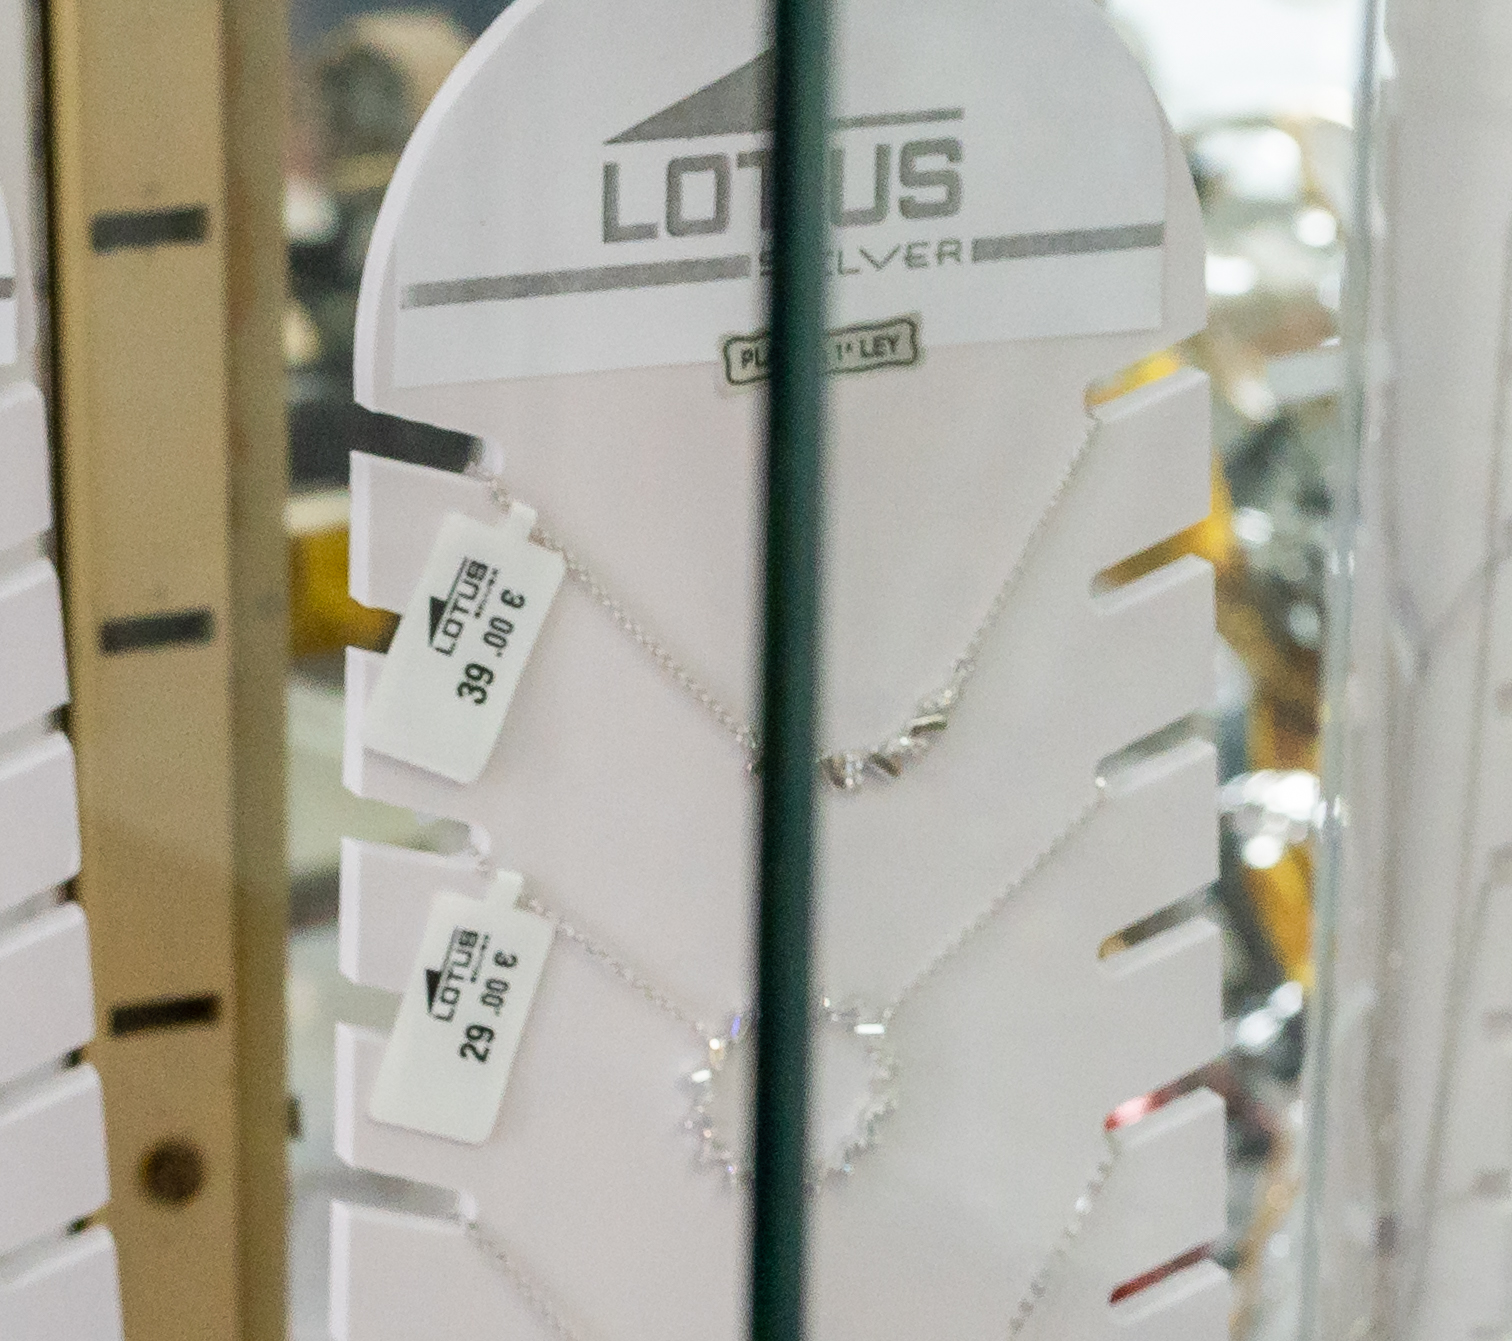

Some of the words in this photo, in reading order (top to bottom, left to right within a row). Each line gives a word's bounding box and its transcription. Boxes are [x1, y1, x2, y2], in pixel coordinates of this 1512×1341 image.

[760, 239, 963, 278] LVER
[860, 333, 901, 357] LEY
[435, 560, 488, 656] LOTUS
[457, 663, 494, 705] 39
[483, 616, 513, 657] .00
[501, 588, 525, 609] €
[429, 929, 478, 1022] LOTUS
[494, 951, 518, 968] €
[482, 978, 509, 1016] .00
[460, 1024, 495, 1063] 29
